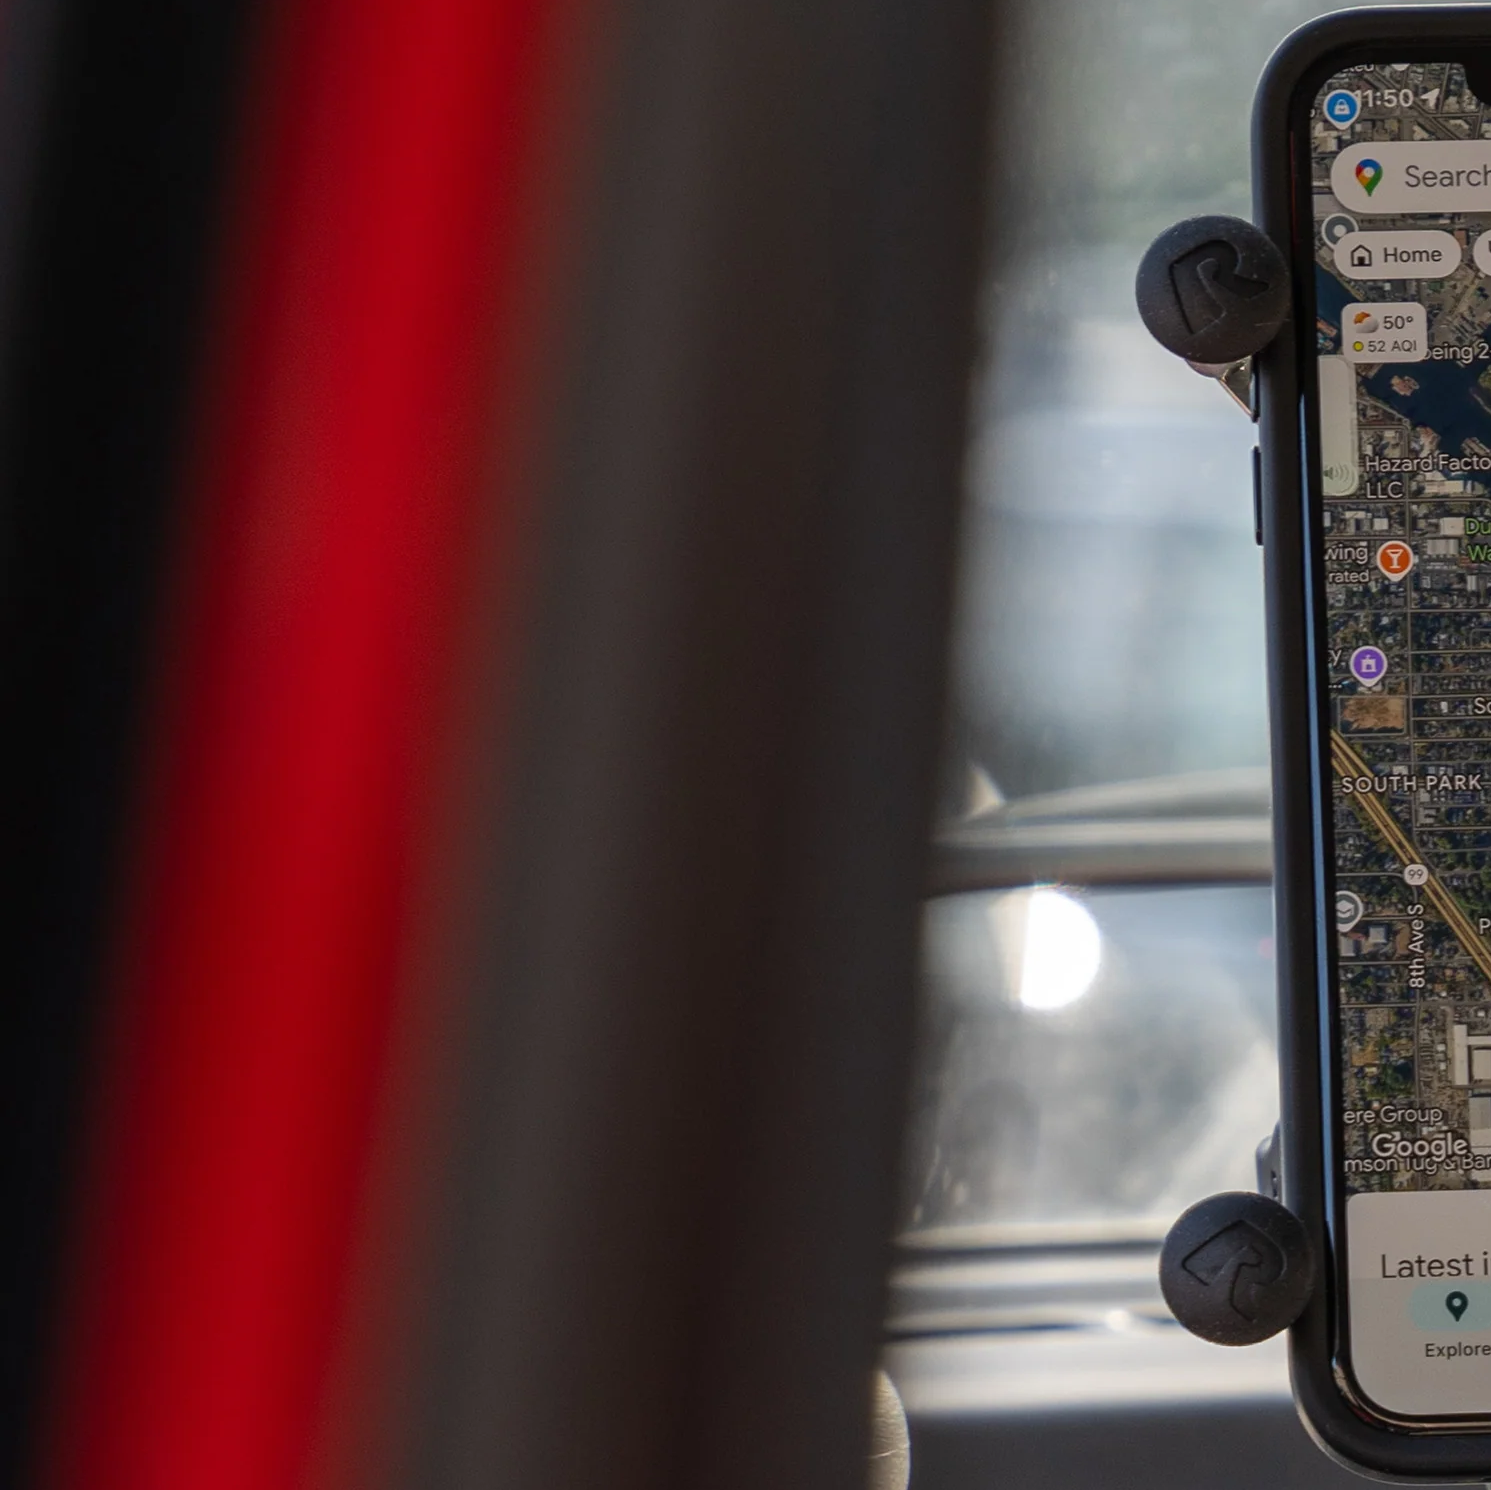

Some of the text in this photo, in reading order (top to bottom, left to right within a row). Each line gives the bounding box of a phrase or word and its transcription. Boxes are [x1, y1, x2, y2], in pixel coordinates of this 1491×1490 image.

[1353, 88, 1414, 108] 11:50
[1384, 247, 1442, 263] Home
[1383, 315, 1413, 330] 50°
[1368, 340, 1417, 353] 52 AQI
[1365, 455, 1432, 472] Hazard
[1366, 482, 1403, 499] LLC
[1342, 774, 1482, 793] SOUTH PARK
[1409, 868, 1423, 880] 99
[1408, 918, 1425, 953] Ave
[1408, 957, 1425, 988] 8th
[1343, 1105, 1443, 1124] ere Group
[1372, 1131, 1468, 1162] Google
[1380, 1252, 1474, 1279] Latest
[1425, 1342, 1491, 1359] Explore
